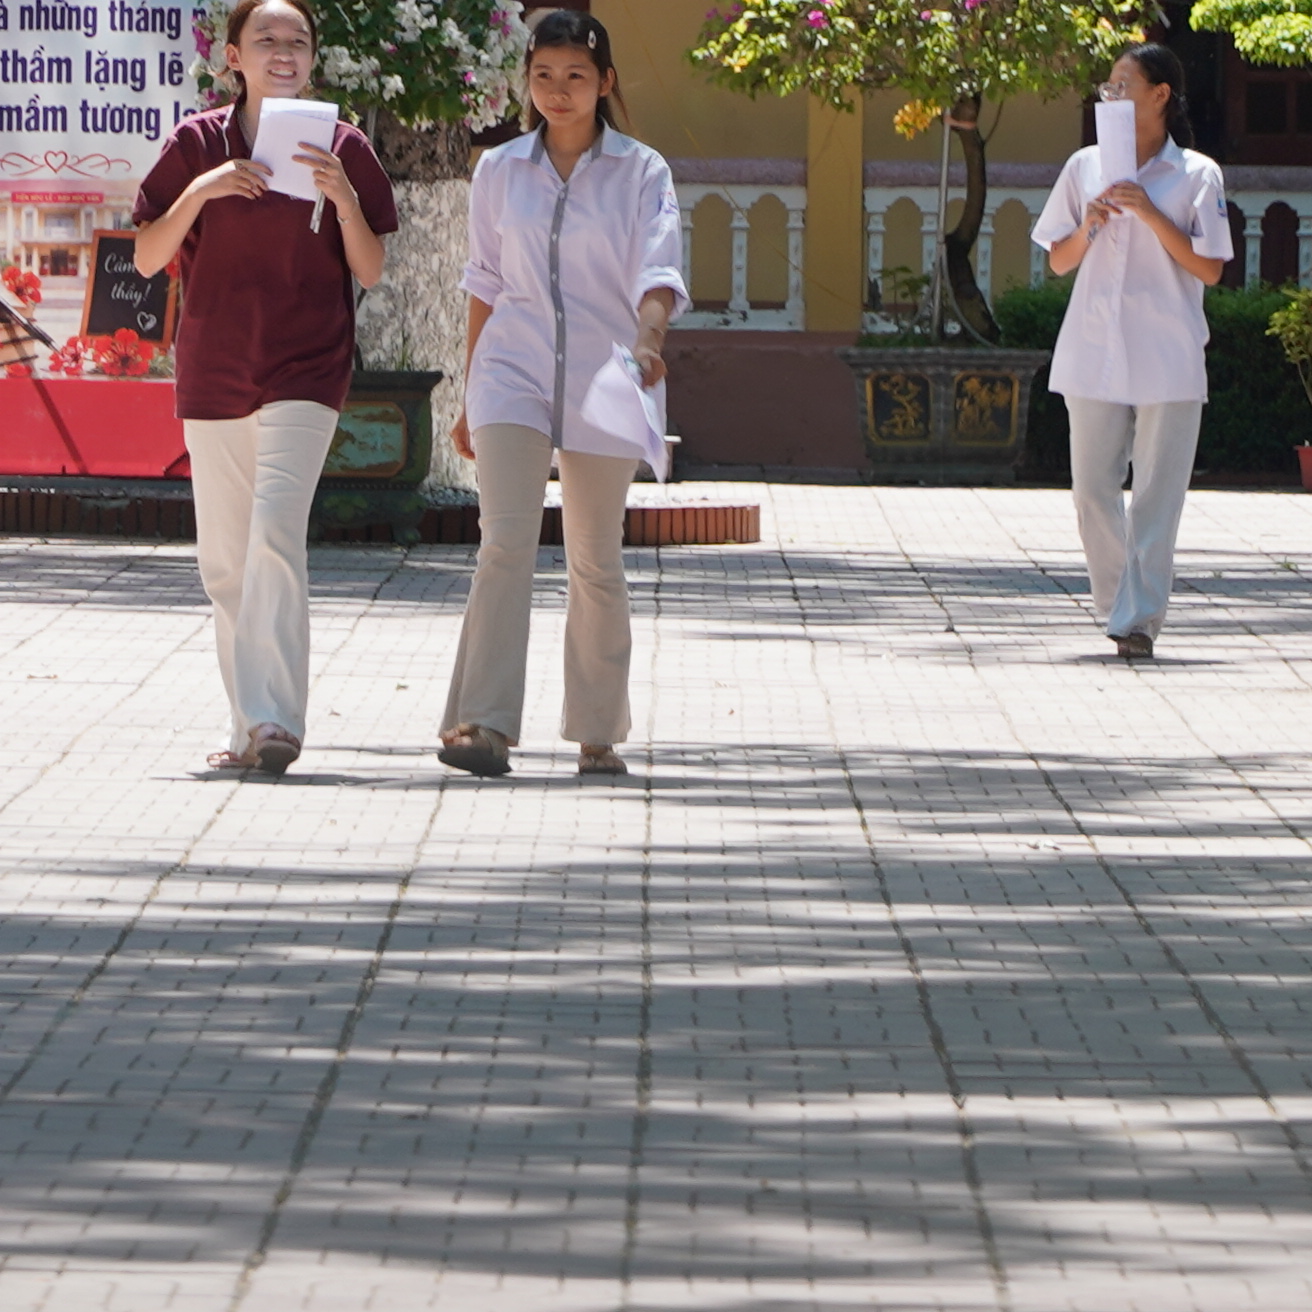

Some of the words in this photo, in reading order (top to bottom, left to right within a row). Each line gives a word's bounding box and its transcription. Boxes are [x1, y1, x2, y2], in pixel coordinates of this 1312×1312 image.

[108, 0, 182, 42] tháng
[0, 43, 71, 85] thầm
[84, 49, 147, 92] lặng
[158, 49, 185, 86] lẽ
[79, 101, 162, 140] tương
